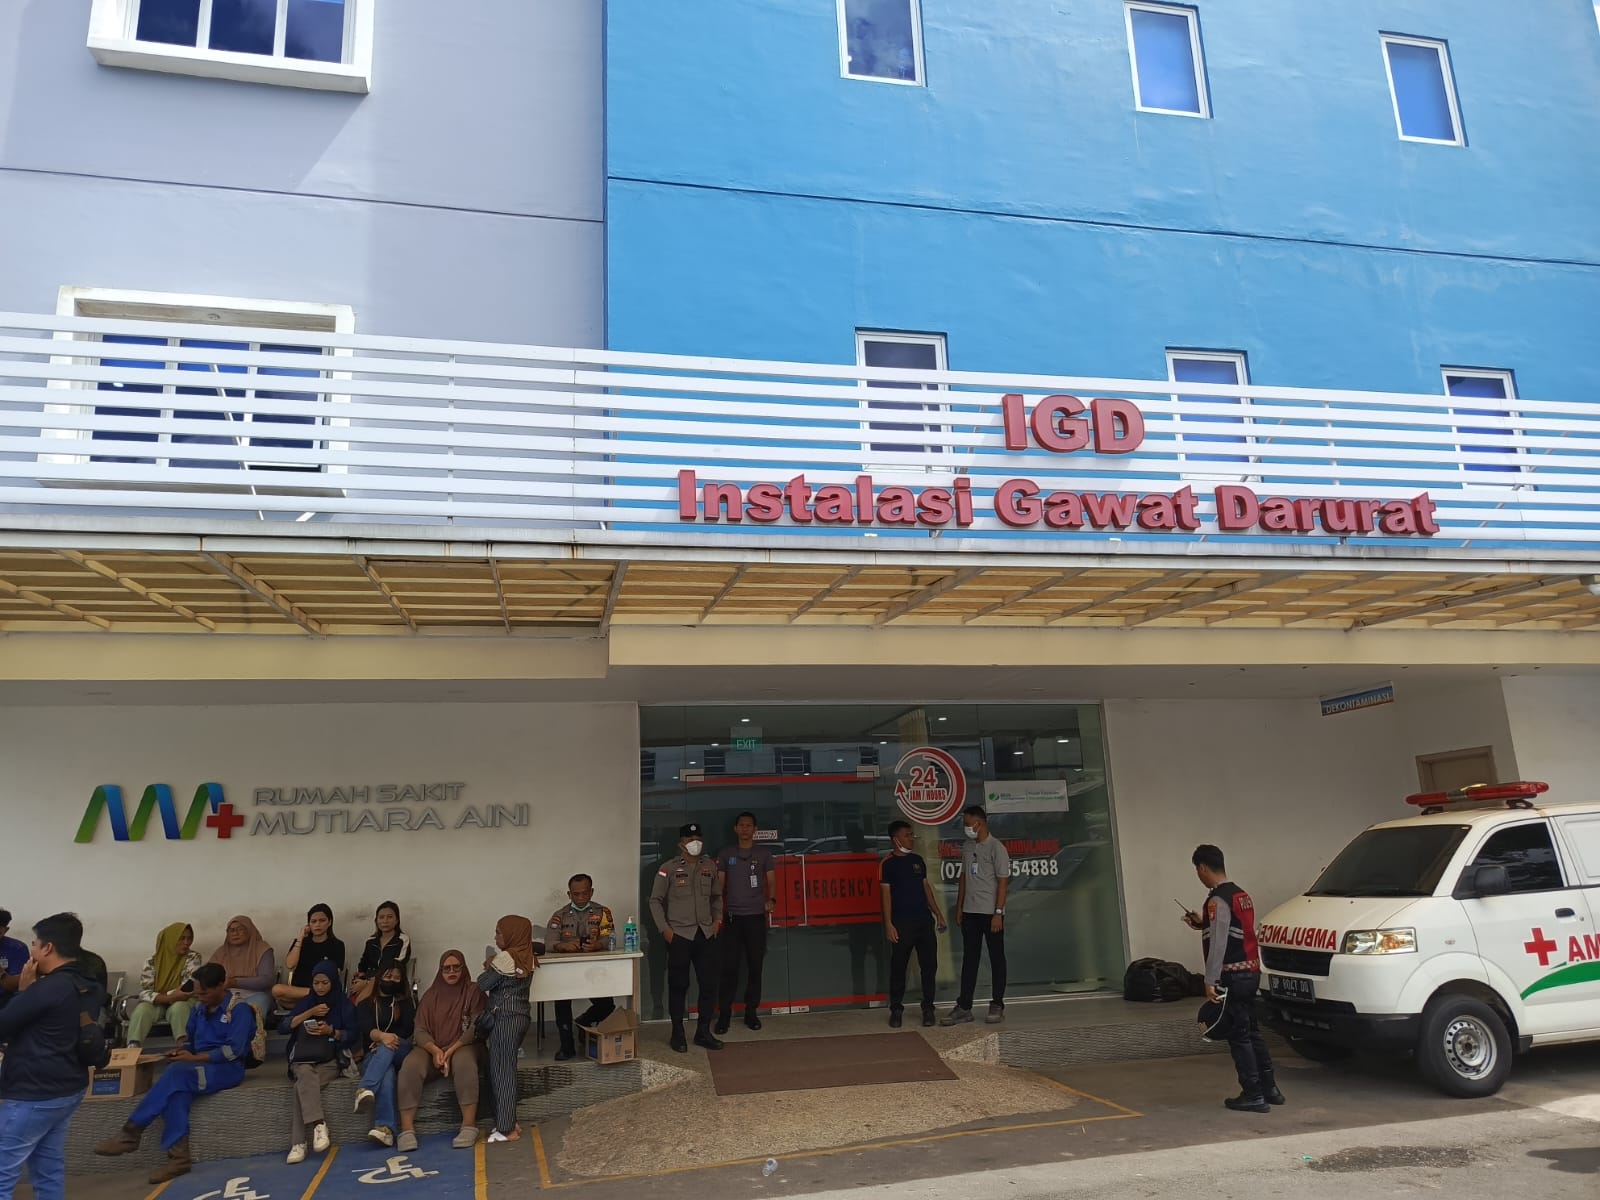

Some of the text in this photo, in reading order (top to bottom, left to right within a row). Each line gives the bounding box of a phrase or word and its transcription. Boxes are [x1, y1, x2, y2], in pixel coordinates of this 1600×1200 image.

[1003, 394, 1145, 455] IGD
[679, 469, 1439, 534] Instalasi Gawat Darurat
[1326, 692, 1391, 713] DEKONTAMINASI
[736, 739, 757, 750] EXIT
[910, 766, 937, 787] 24
[253, 781, 466, 807] RUMAH SAKIT
[909, 788, 922, 801] JAM
[926, 788, 947, 801] HOURS
[249, 802, 531, 837] MUTIARA AINI
[793, 877, 873, 900] EMERGENCY
